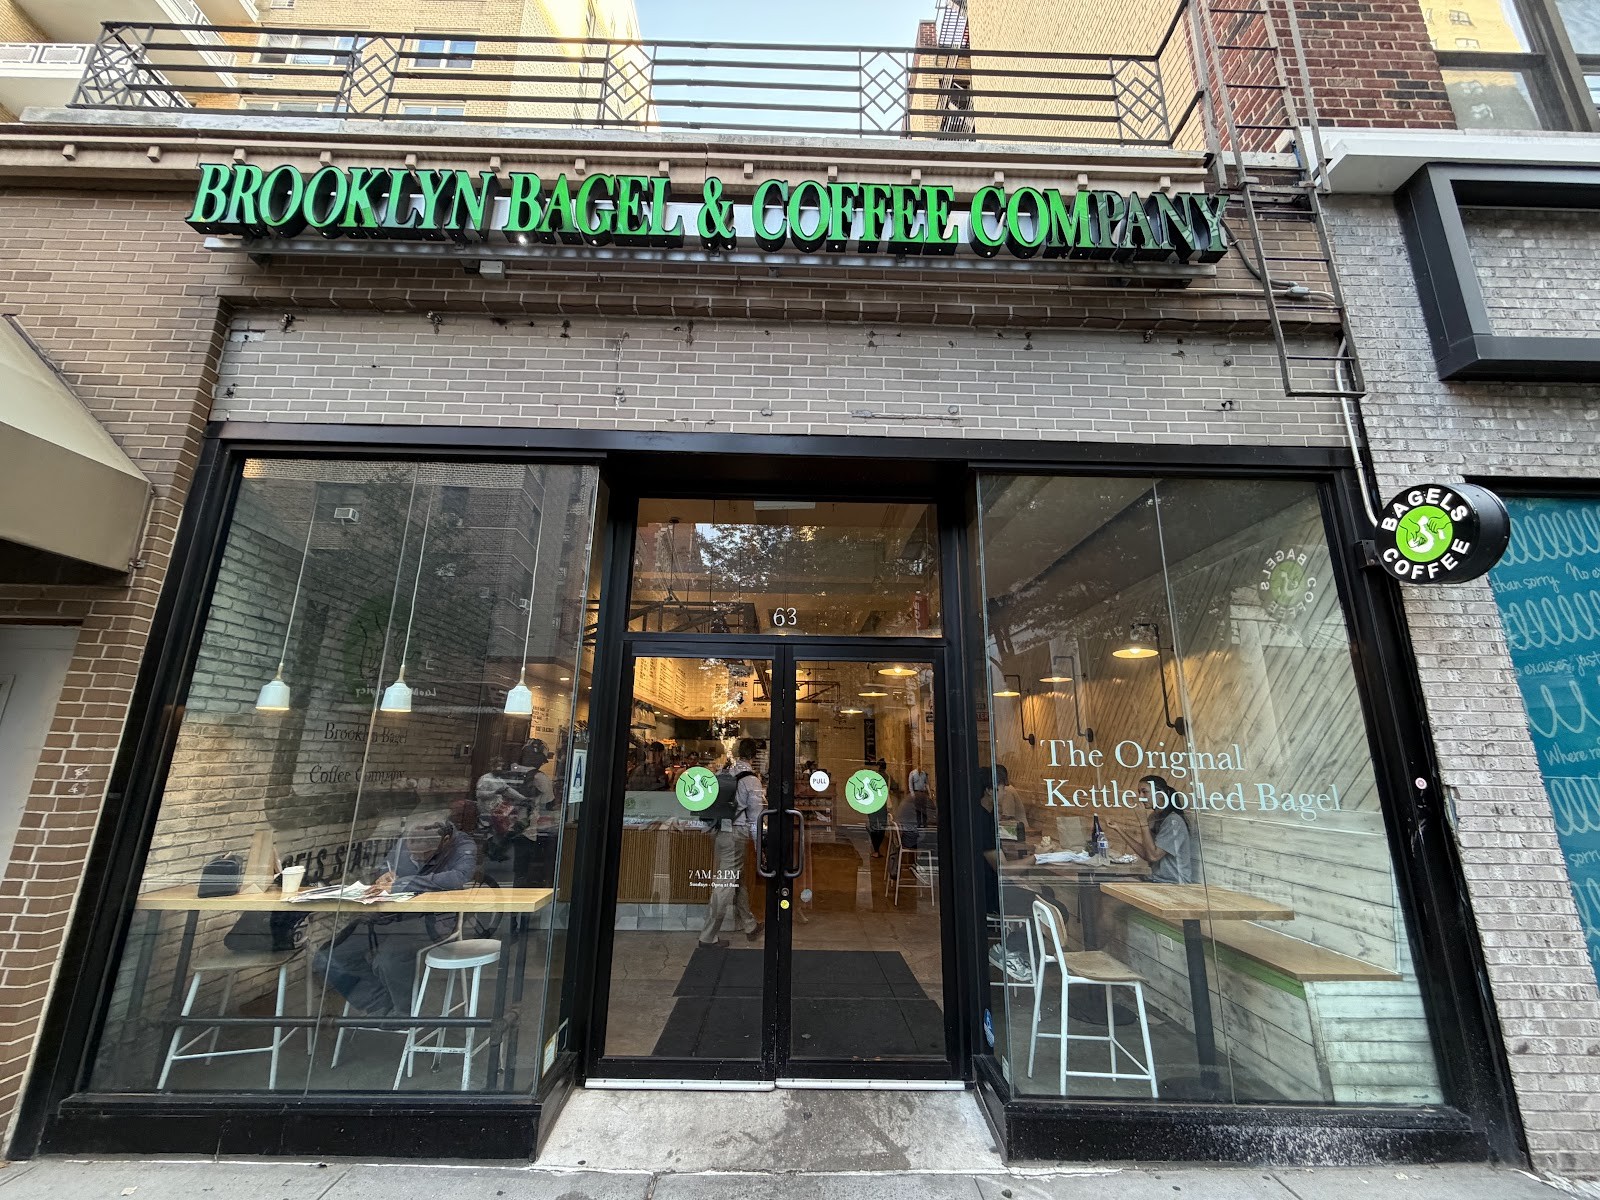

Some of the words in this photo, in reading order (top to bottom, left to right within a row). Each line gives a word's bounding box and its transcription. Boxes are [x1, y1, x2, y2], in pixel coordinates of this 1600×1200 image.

[187, 163, 497, 237] BROOKLYN
[503, 171, 684, 242] BAGEL
[698, 176, 737, 242] &
[751, 178, 959, 246] COFFEE
[969, 185, 1229, 256] COMPANY
[1381, 487, 1469, 532] BAGELS
[1383, 538, 1470, 580] COFFEE
[773, 607, 797, 627] 63
[323, 721, 378, 744] Brookln
[573, 756, 582, 788] A
[1040, 739, 1104, 769] The
[1114, 740, 1246, 779] Original
[1043, 778, 1247, 812] Kettle-boiled
[1253, 783, 1343, 822] Bagel
